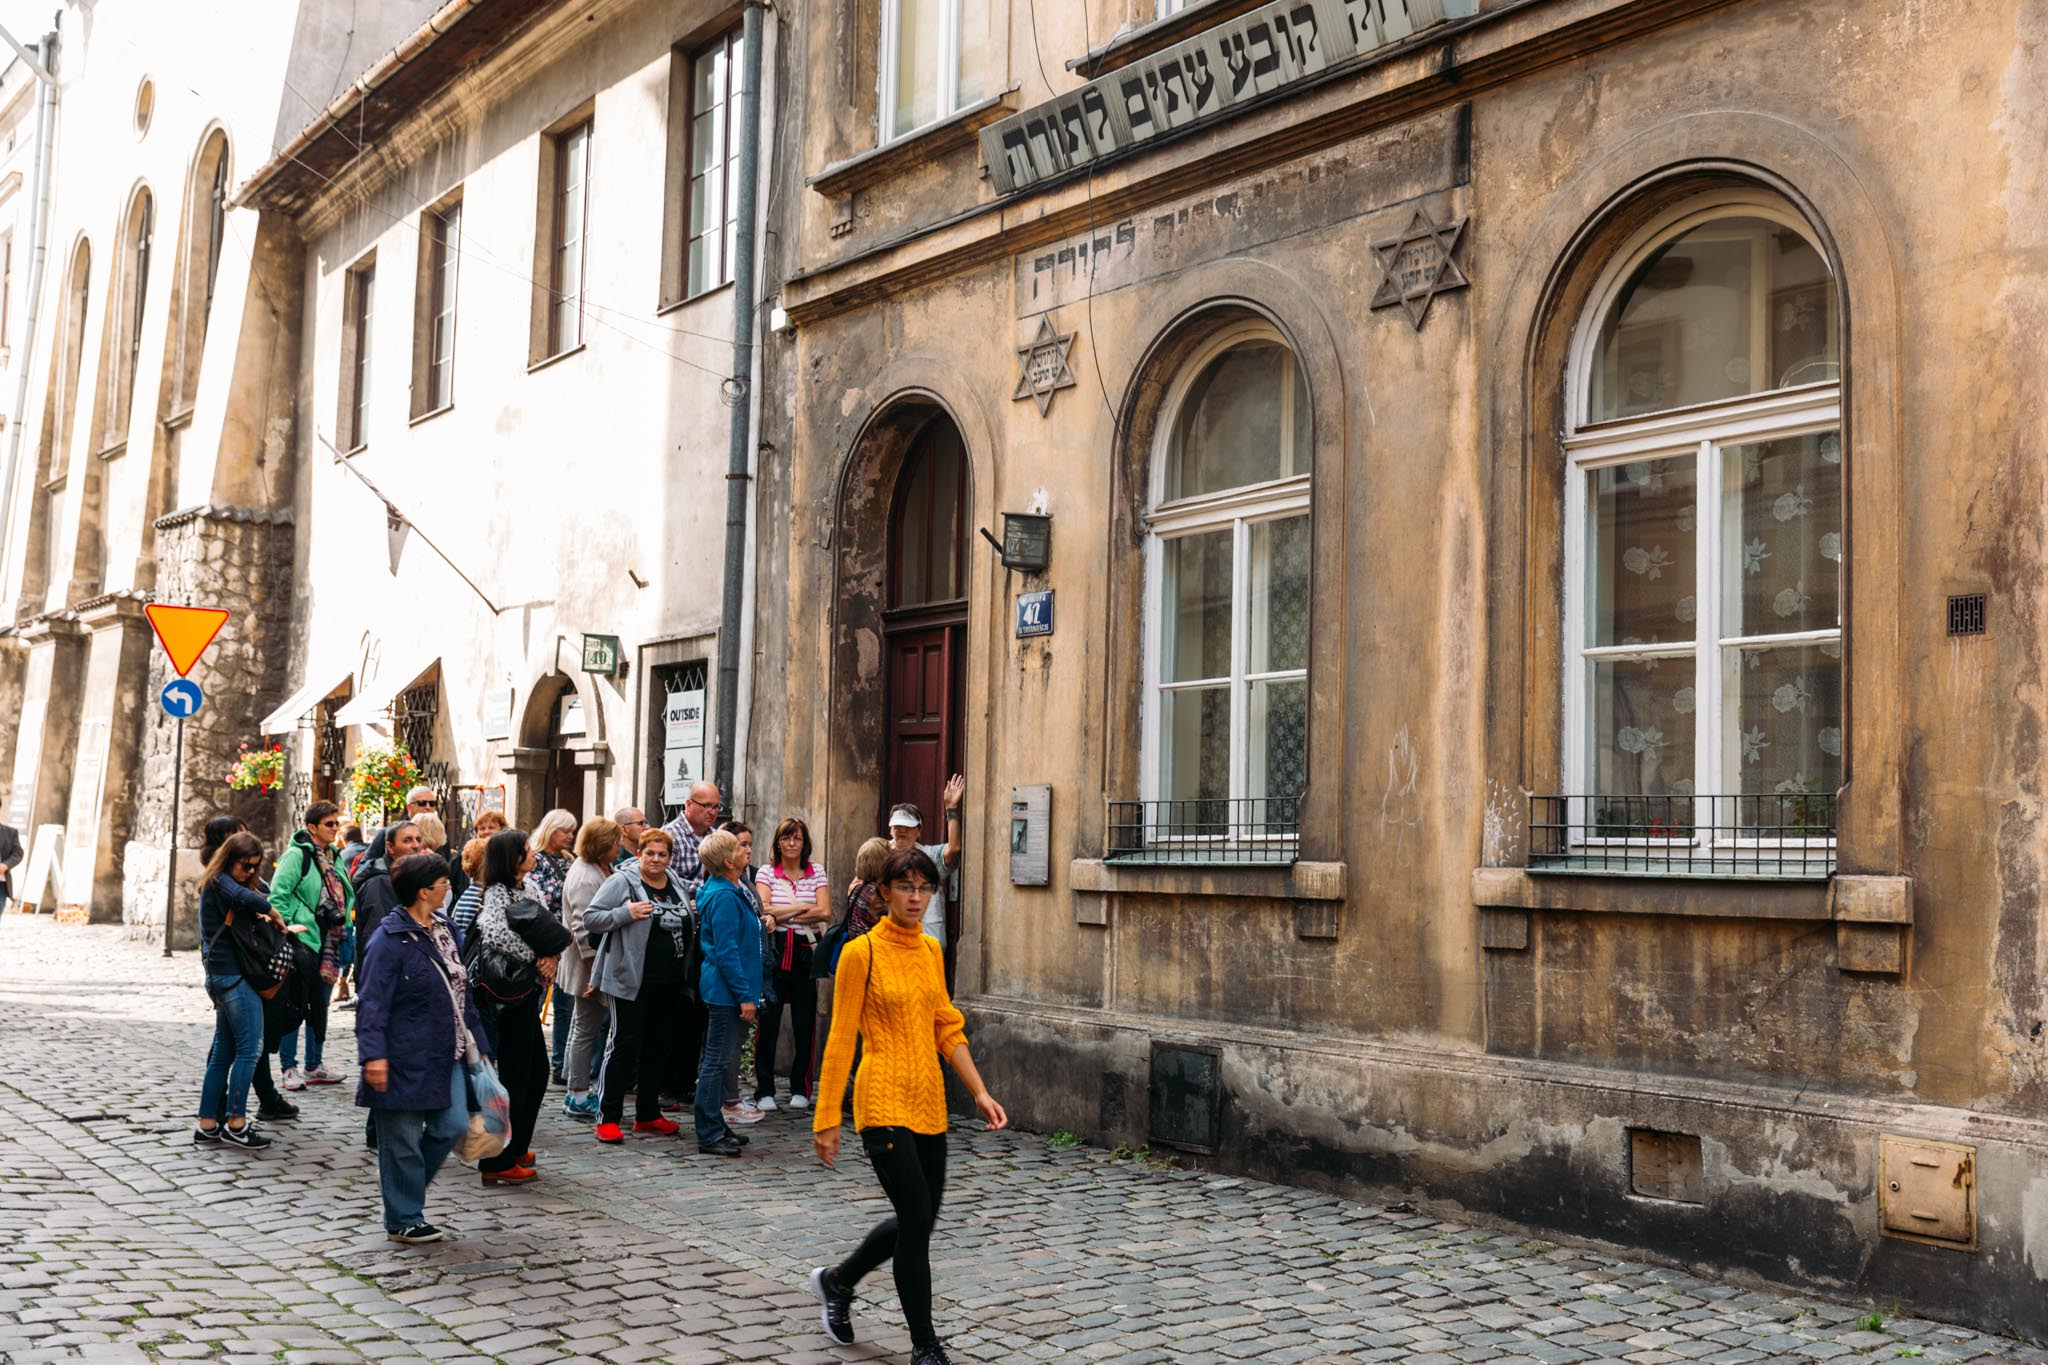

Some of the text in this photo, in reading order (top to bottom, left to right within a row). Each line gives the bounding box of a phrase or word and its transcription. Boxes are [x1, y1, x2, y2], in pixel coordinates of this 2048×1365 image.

[1121, 48, 1216, 128] עתים
[1221, 5, 1318, 95] קובע
[1002, 85, 1108, 183] לתורה
[1033, 218, 1136, 300] לתורה
[1023, 602, 1041, 625] 42
[591, 651, 607, 665] 40
[669, 707, 700, 721] OUTSIDE
